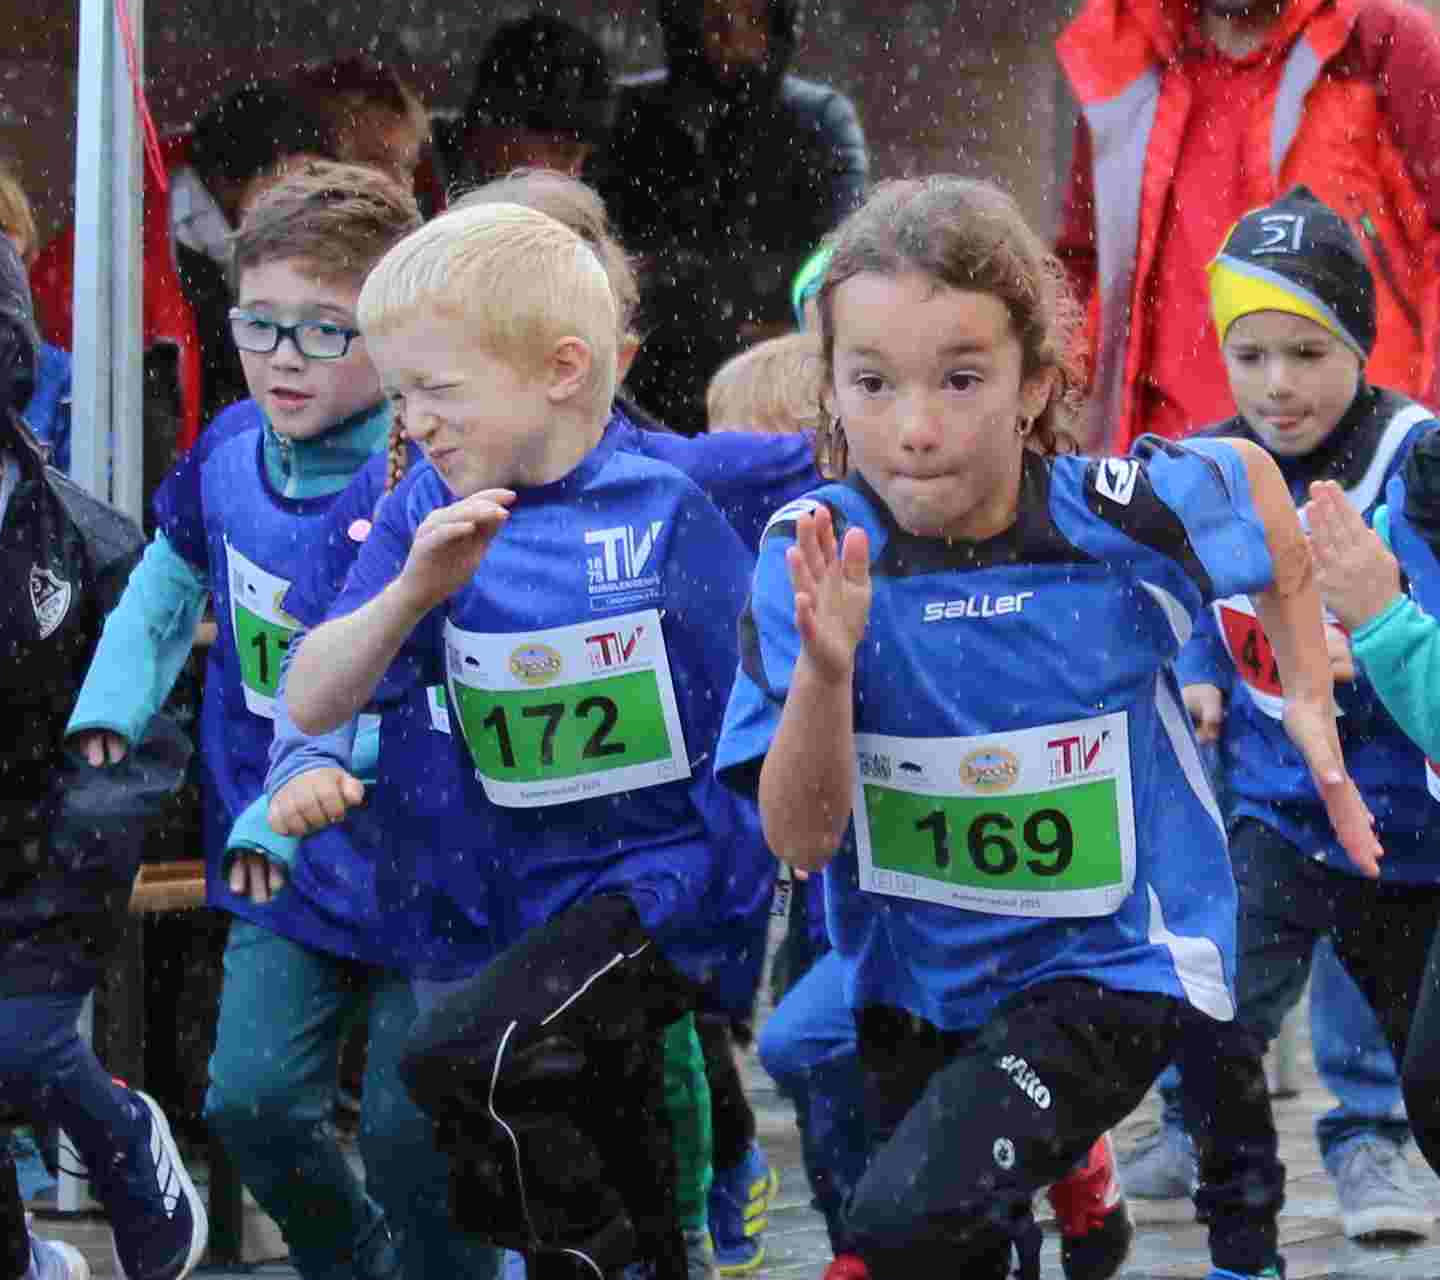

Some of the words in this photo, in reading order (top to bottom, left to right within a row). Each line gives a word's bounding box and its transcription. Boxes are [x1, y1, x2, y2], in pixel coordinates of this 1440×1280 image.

[922, 591, 1034, 622] saller
[483, 695, 626, 768] 172
[914, 808, 1074, 877] 169
